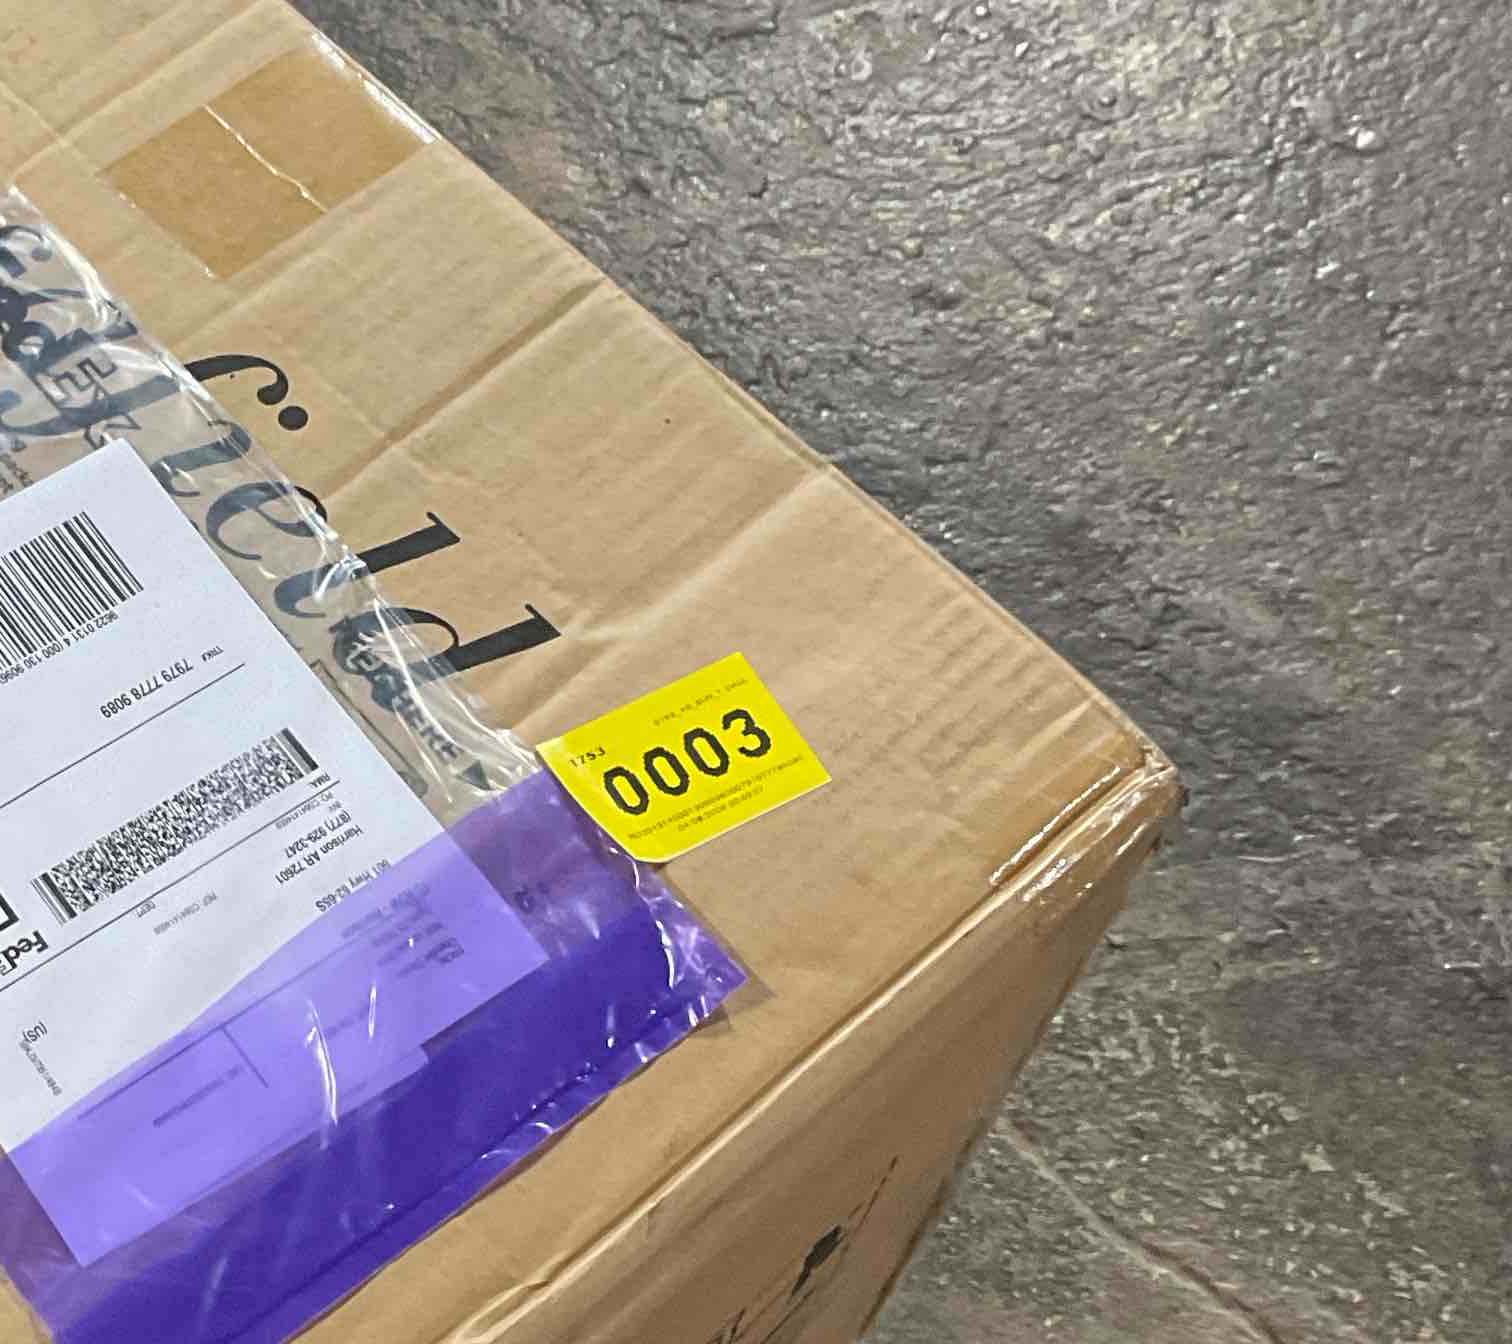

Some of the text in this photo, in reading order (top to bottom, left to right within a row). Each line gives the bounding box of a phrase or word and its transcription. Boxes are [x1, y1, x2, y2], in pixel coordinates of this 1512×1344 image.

[69, 622, 95, 643] 0131
[92, 609, 118, 629] 9622
[40, 639, 64, 659] (000
[158, 656, 193, 684] 7979
[128, 674, 162, 701] 7778
[97, 691, 132, 719] 9089
[603, 709, 771, 816] 0003
[274, 824, 363, 885] Harrison AR 72601
[20, 1021, 49, 1046] (US)
